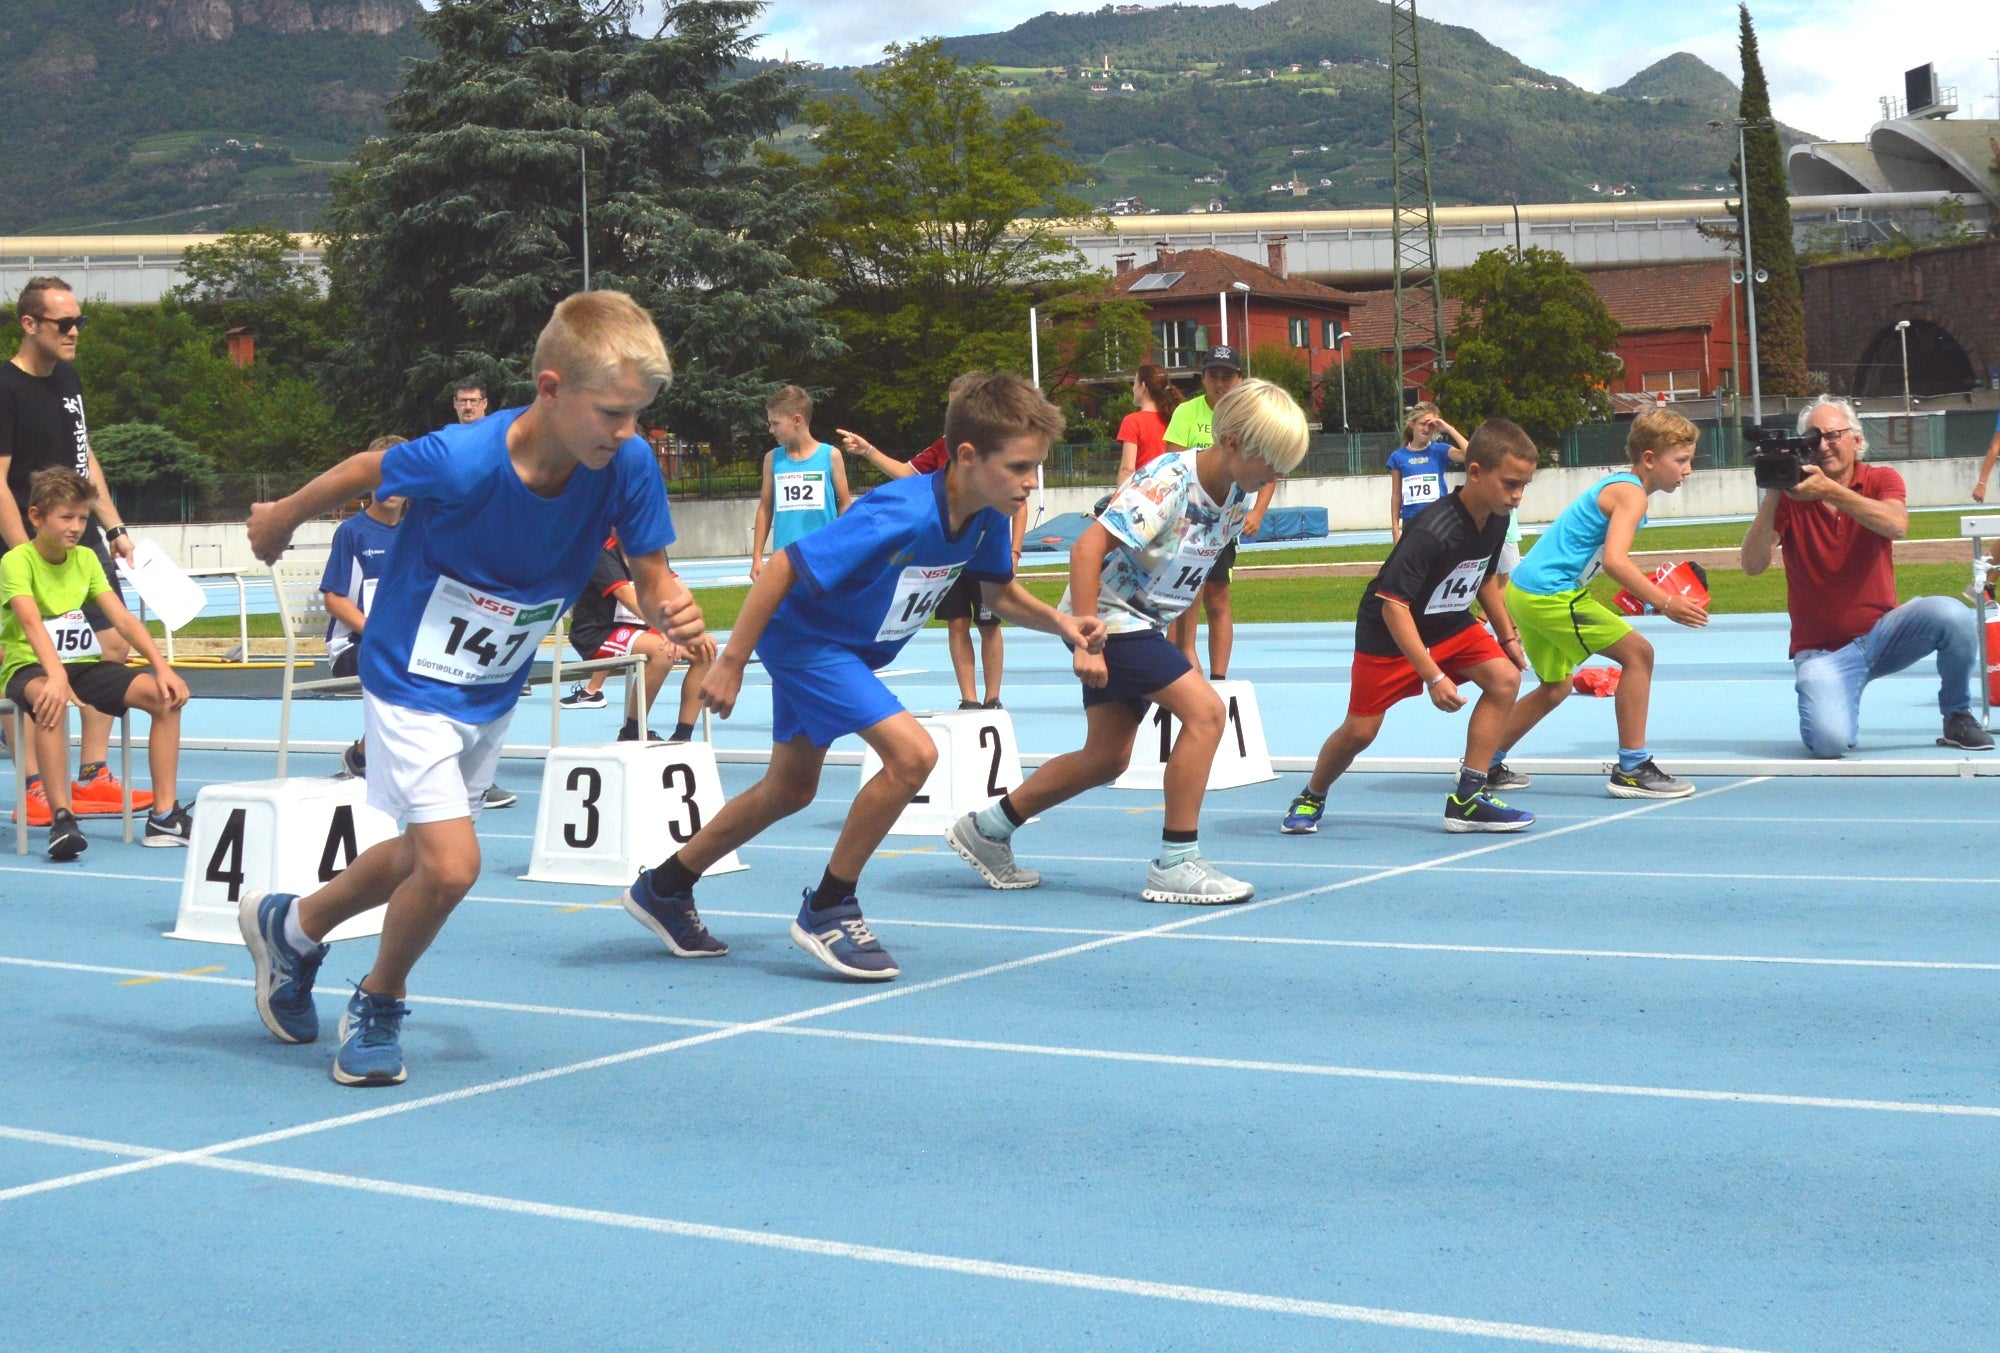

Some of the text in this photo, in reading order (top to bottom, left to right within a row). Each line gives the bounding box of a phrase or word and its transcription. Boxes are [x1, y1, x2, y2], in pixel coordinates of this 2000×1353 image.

[1197, 423, 1211, 433] YE
[783, 484, 813, 501] 192
[1409, 484, 1431, 497] 178
[921, 568, 949, 578] VSS
[468, 592, 516, 617] VSS
[56, 629, 92, 651] 150
[444, 616, 530, 667] 147
[416, 658, 464, 678] SÜDTIROLER
[1153, 703, 1172, 763] 1
[1228, 695, 1247, 758] 1
[979, 725, 1007, 797] 2
[563, 766, 601, 849] 3
[661, 762, 701, 844] 3
[205, 808, 247, 902] 4
[317, 804, 360, 884] 4
